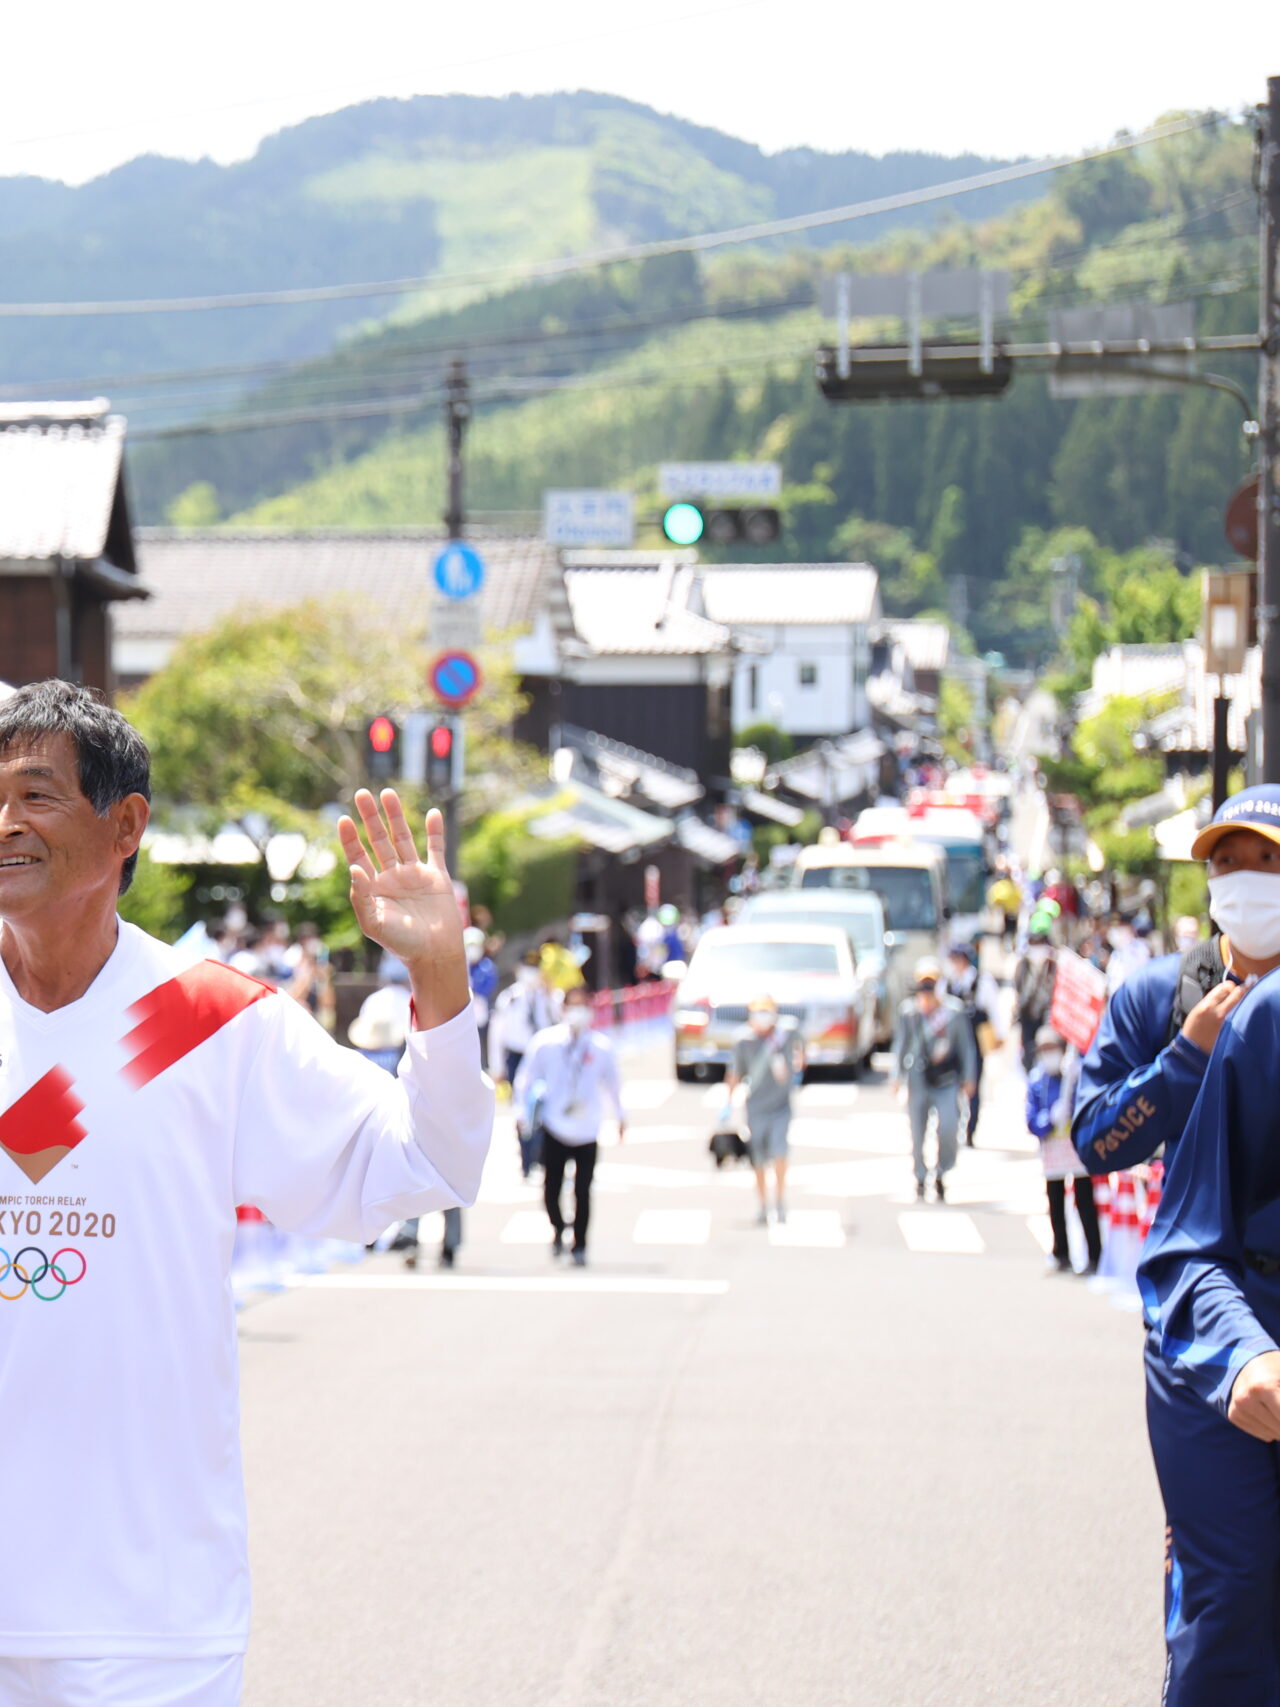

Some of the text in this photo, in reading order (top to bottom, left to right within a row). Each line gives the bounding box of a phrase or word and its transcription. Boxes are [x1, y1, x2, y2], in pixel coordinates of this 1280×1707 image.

[1255, 800, 1280, 817] 202
[1093, 1094, 1156, 1161] POLICE
[25, 1196, 55, 1205] TORCH
[57, 1197, 87, 1206] RELAY
[48, 1211, 115, 1238] 2020
